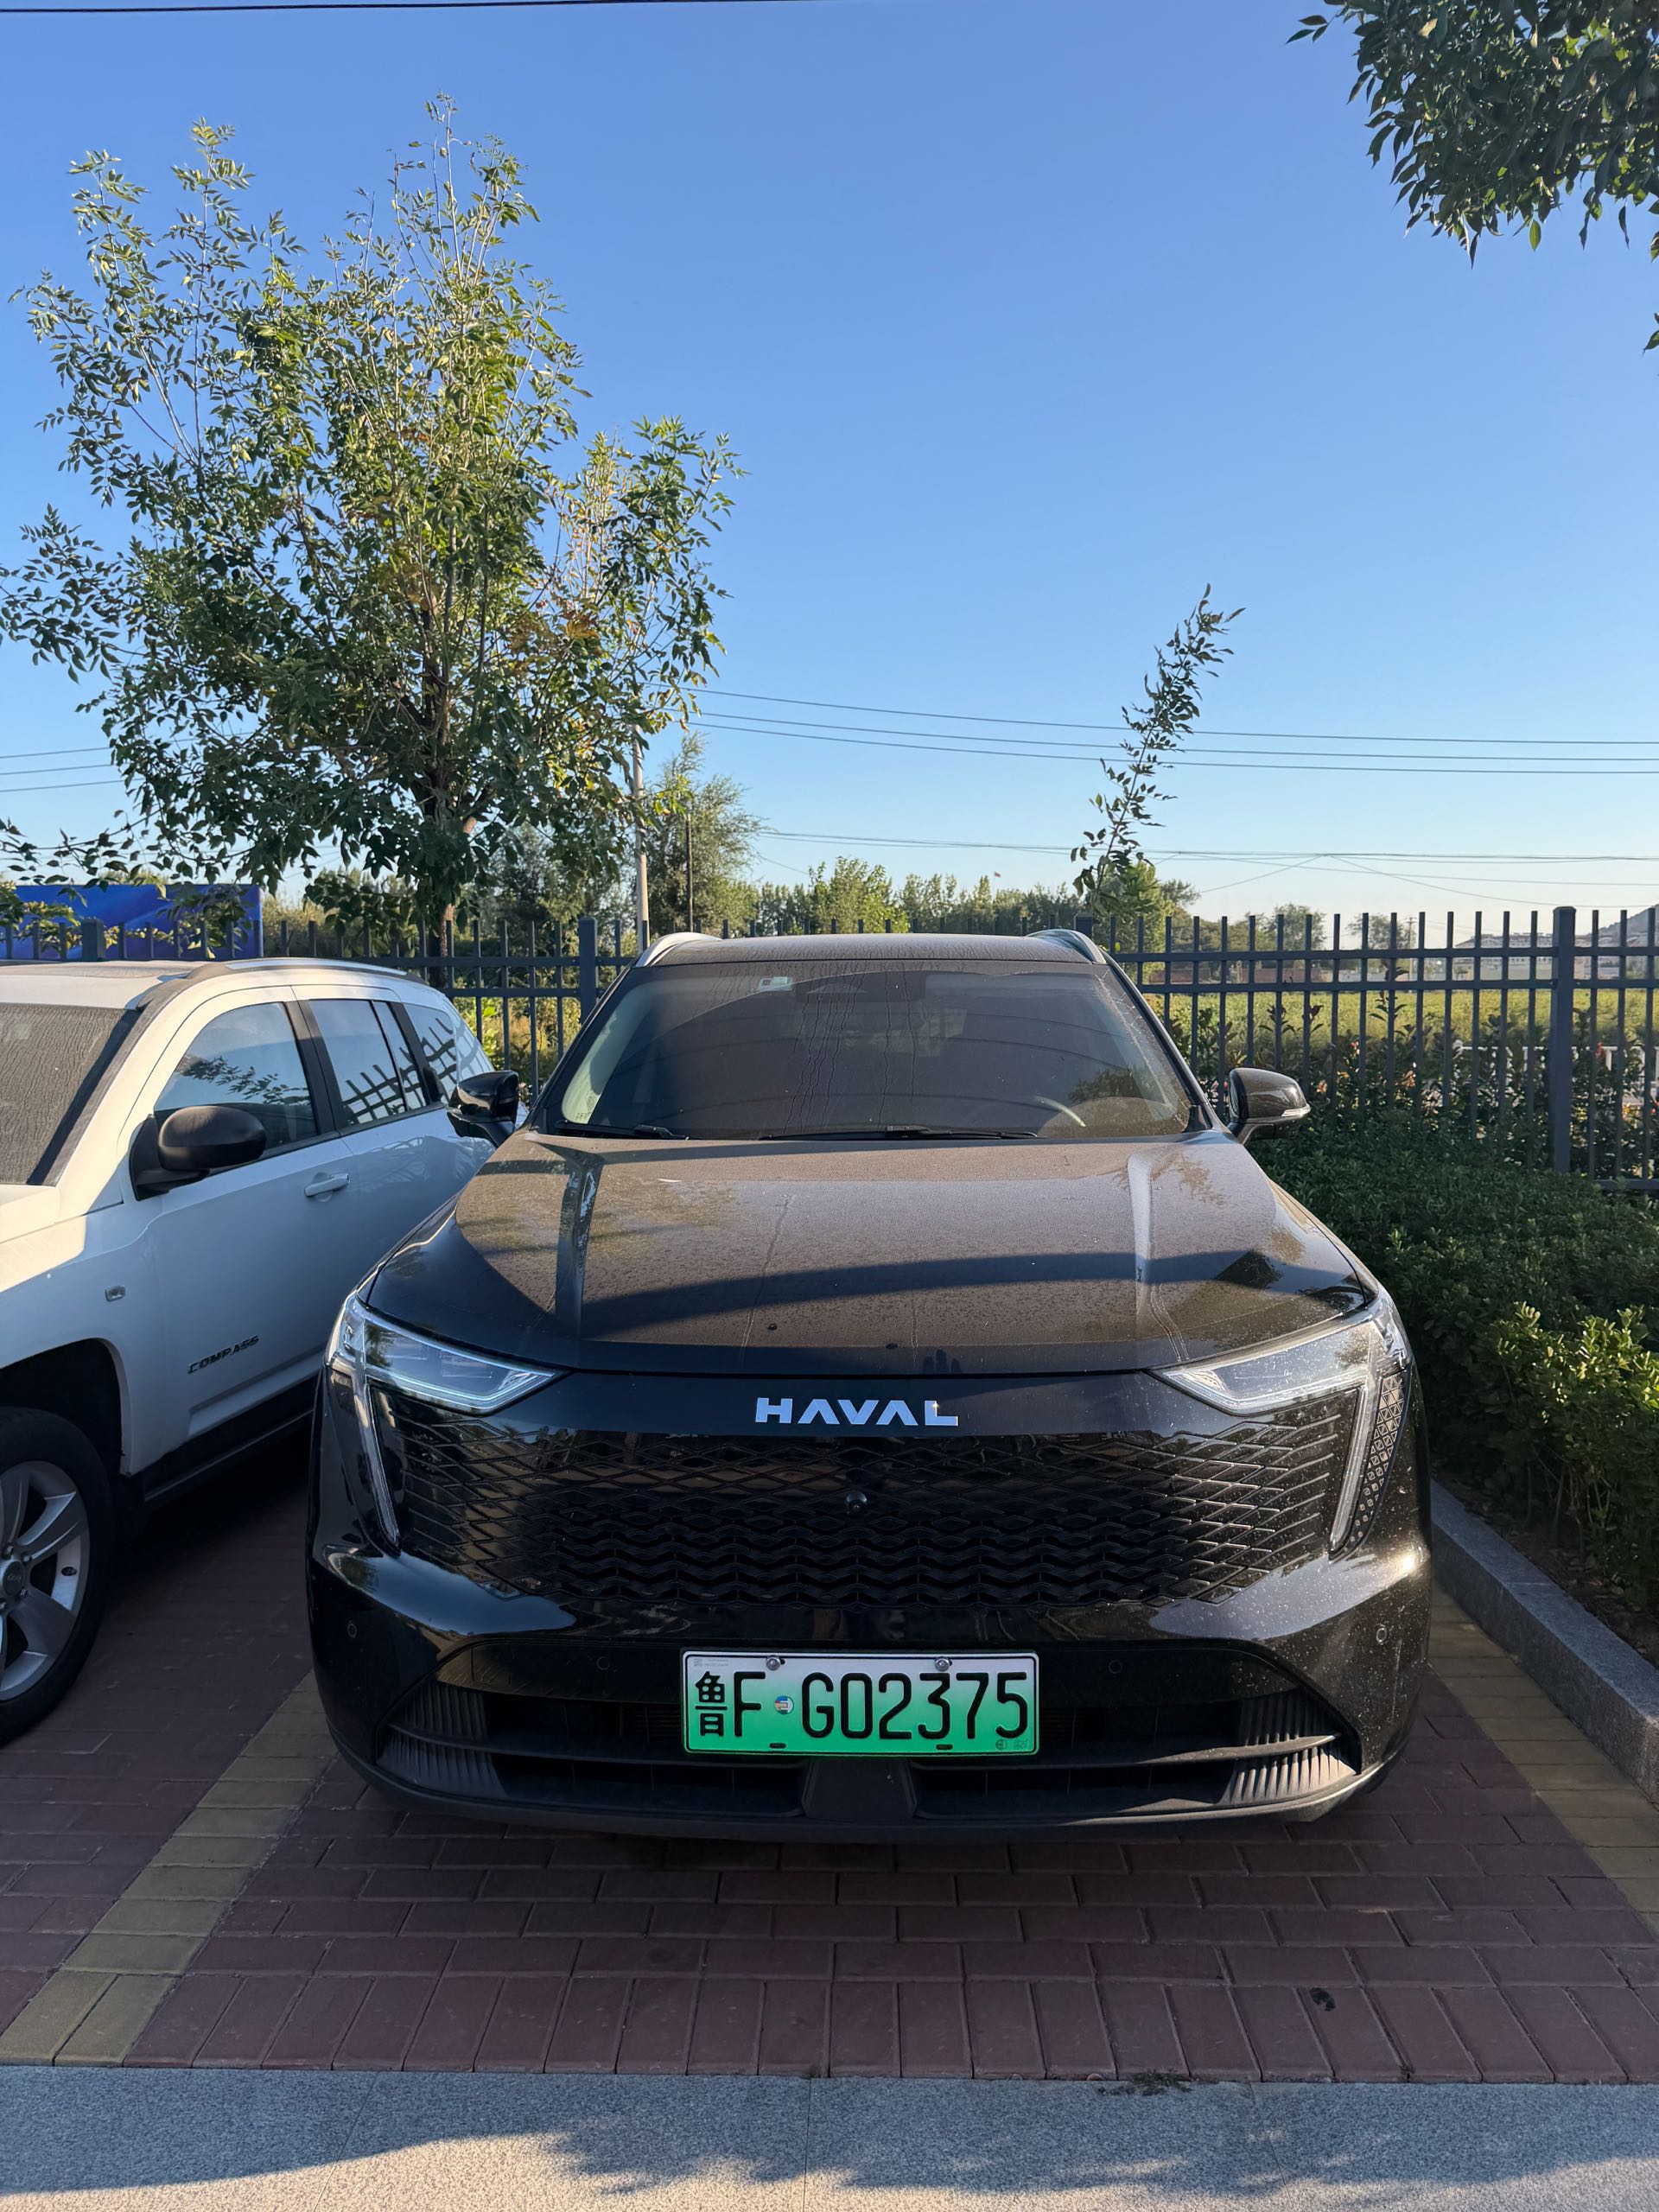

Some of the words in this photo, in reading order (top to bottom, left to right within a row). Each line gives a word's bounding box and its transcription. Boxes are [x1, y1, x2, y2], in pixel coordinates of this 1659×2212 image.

[188, 1334, 259, 1374] COMPASS
[755, 1397, 959, 1427] HAVAL
[801, 1671, 1028, 1740] G02375
